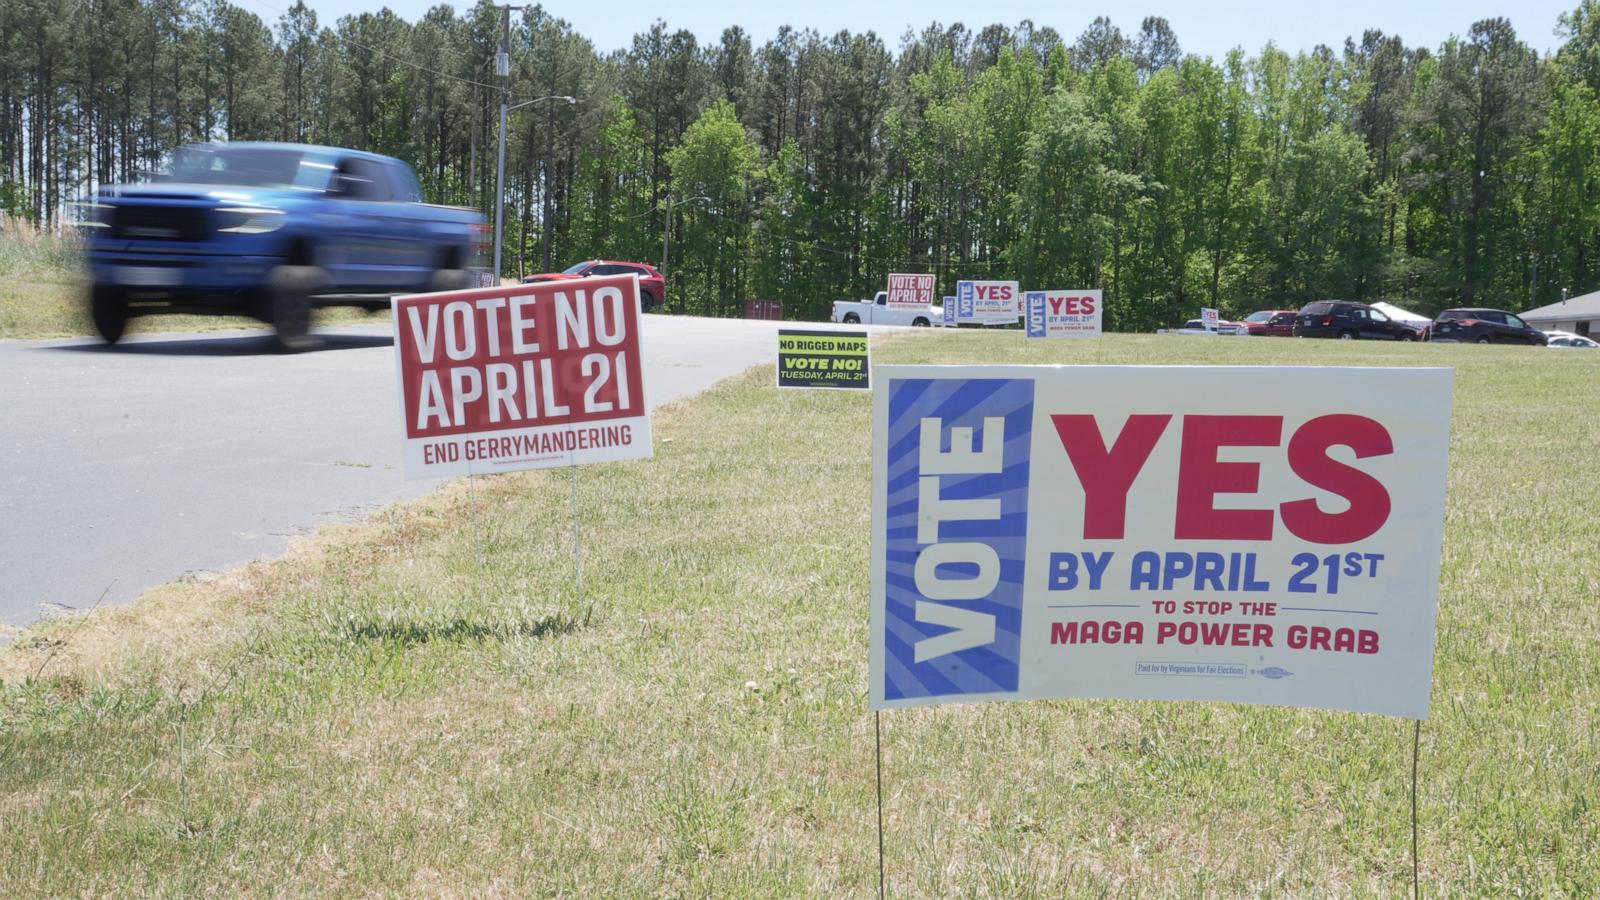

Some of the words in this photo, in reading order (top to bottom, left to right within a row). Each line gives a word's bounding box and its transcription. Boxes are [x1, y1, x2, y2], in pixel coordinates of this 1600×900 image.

[891, 276, 916, 289] VOTE
[917, 276, 932, 289] NO
[975, 285, 1012, 300] YES
[889, 288, 918, 302] APRIL
[919, 290, 930, 302] 21
[960, 285, 971, 313] VOTE
[1048, 296, 1095, 315] YES
[945, 300, 954, 321] VOTE
[1030, 297, 1043, 333] VOTE
[407, 294, 540, 364] VOTE
[554, 286, 626, 350] NO
[780, 340, 794, 349] NO
[797, 341, 834, 351] RIGGED
[837, 342, 866, 352] MAPS
[784, 357, 830, 369] VOTE
[832, 359, 863, 371] NO!
[780, 370, 823, 380] TUESDAY,
[825, 372, 852, 380] APRIL
[416, 358, 571, 430] APRIL
[580, 351, 630, 414] 21
[423, 441, 459, 465] END
[464, 425, 632, 461] GERRYMANDERING
[1050, 412, 1394, 544] YES
[914, 416, 1005, 664] VOTE
[1047, 551, 1115, 592] BY
[1129, 551, 1271, 592] APRIL
[1287, 551, 1385, 594] 21ST
[1151, 600, 1176, 615] TO
[1182, 601, 1233, 615] STOP
[1238, 601, 1277, 616] THE
[1050, 620, 1144, 645] MAGA
[1156, 621, 1275, 648] POWER
[1286, 624, 1380, 655] GRAB
[1137, 663, 1151, 672] Paid
[1151, 664, 1160, 673] for
[1160, 664, 1168, 674] by
[1168, 664, 1197, 674] Virginians
[1197, 665, 1206, 674] for
[1206, 665, 1217, 674] Fair
[1217, 665, 1244, 675] Elections
